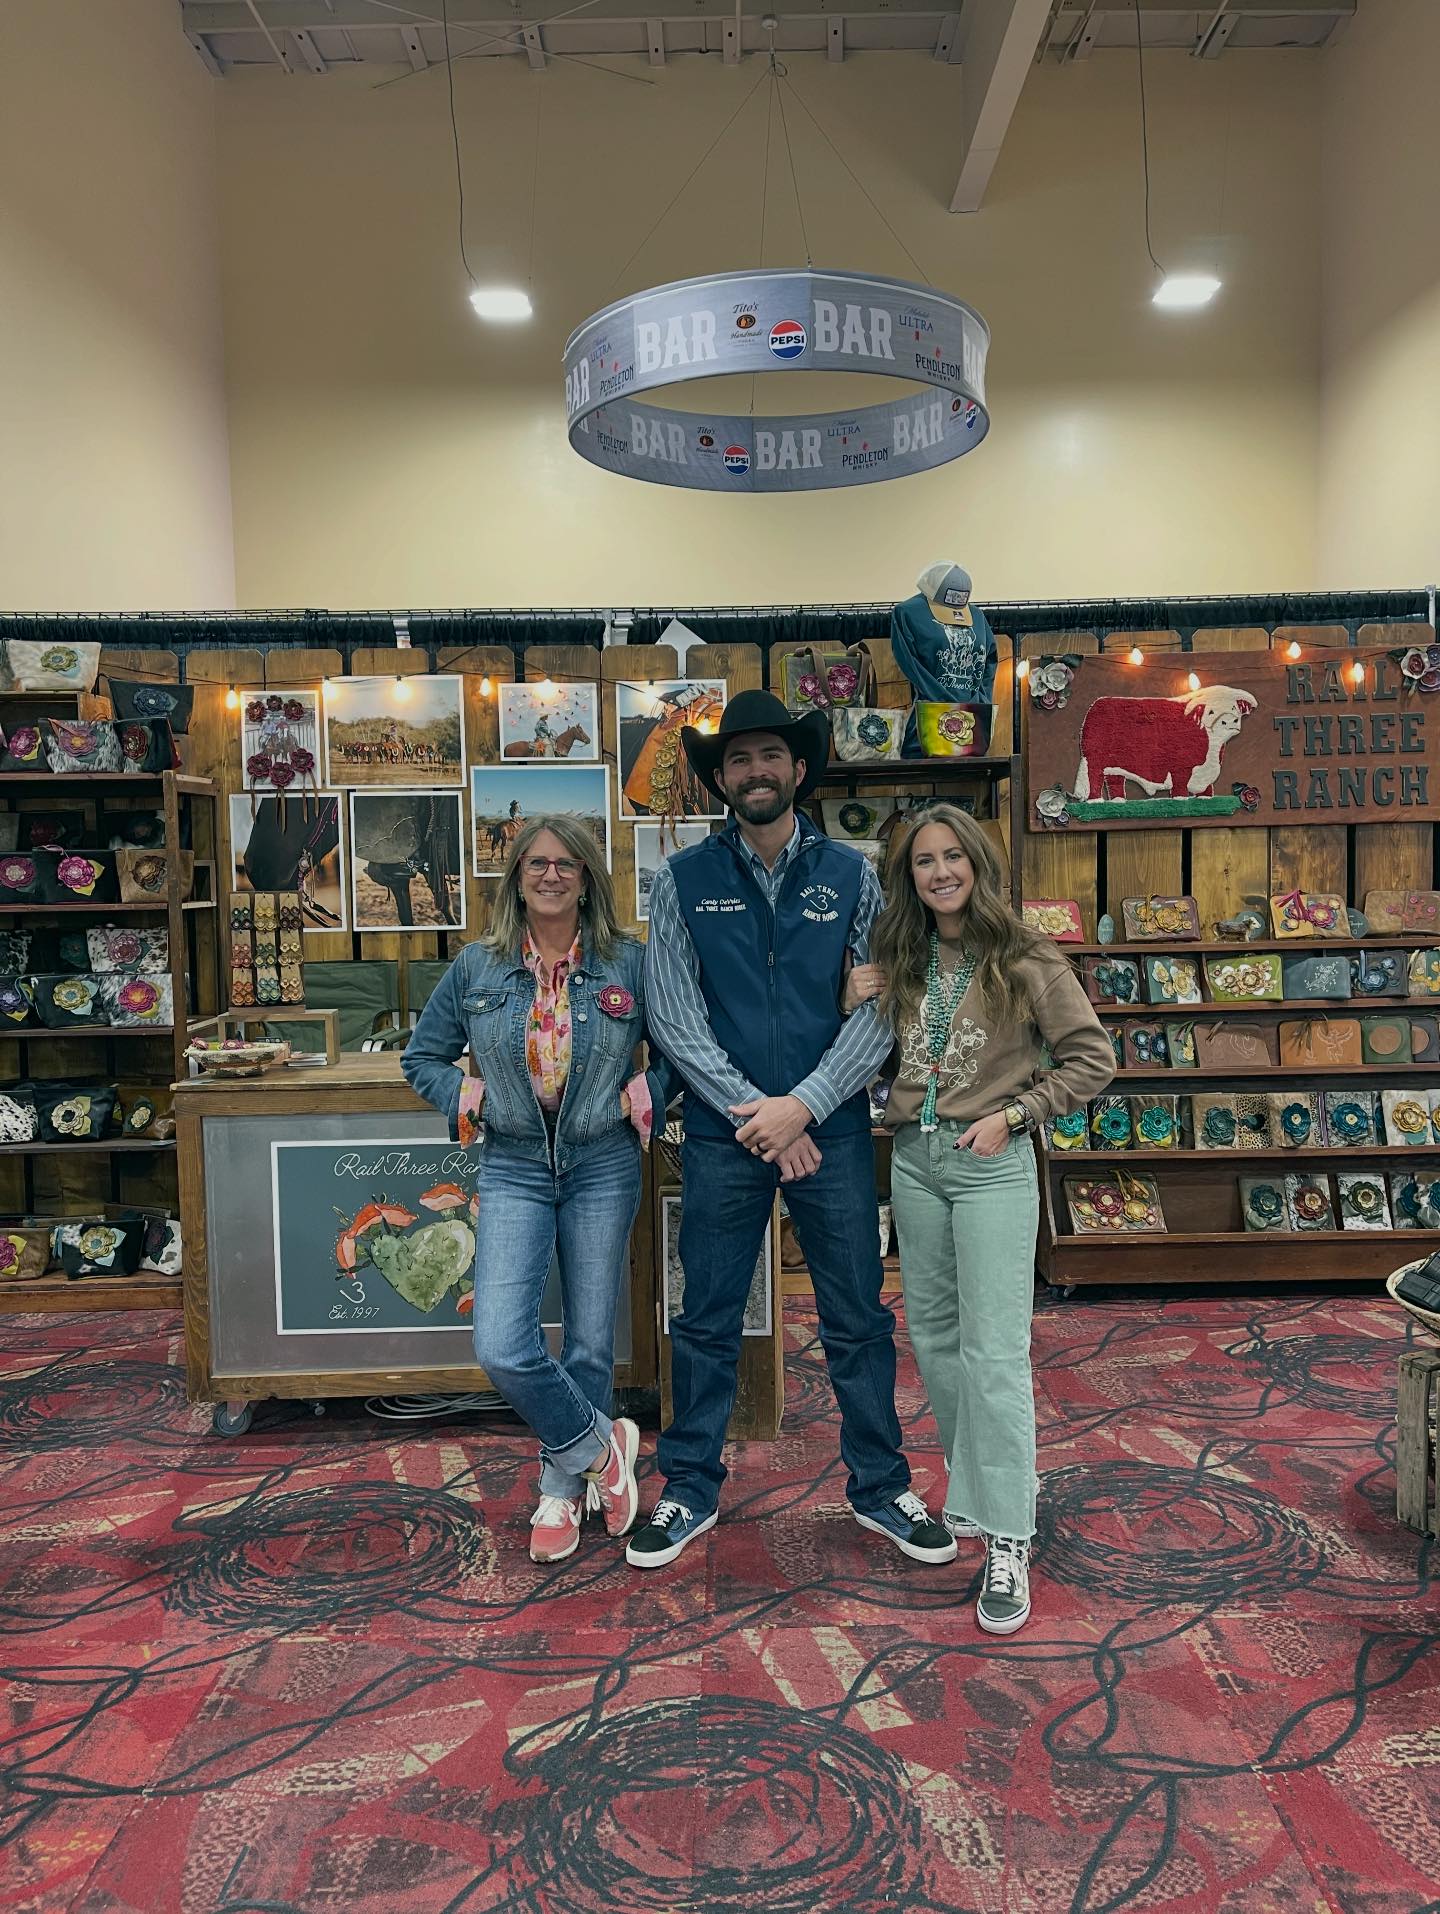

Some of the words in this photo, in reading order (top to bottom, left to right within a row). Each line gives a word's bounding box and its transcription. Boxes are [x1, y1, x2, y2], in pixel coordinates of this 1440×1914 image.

[733, 302, 759, 313] Tito's
[812, 300, 896, 360] BAR
[899, 315, 934, 333] ULTRA
[591, 343, 612, 362] ULTRA
[638, 311, 718, 374] BAR
[771, 335, 805, 345] PEPSI
[915, 353, 961, 381] PENDLETON
[566, 357, 590, 418] BAR
[600, 364, 634, 396] PENDLETON
[597, 429, 628, 452] PENDLETON
[630, 414, 688, 464] BAR
[697, 426, 716, 434] Tito's
[828, 425, 861, 437] ULTRA
[893, 401, 944, 456] BAR
[725, 456, 749, 465] PEPSI
[756, 429, 823, 470] BAR
[842, 447, 888, 467] PENDLETON
[853, 462, 878, 471] WHISKY
[1286, 658, 1397, 704] RAIL
[1273, 712, 1425, 756] THREE
[1272, 765, 1429, 809] RANCH
[800, 886, 815, 898] RAIL
[817, 885, 839, 900] THREE
[334, 1153, 384, 1180] Rail
[383, 1152, 439, 1176] Three
[328, 1304, 348, 1320] Est.
[351, 1306, 380, 1319] 1997
